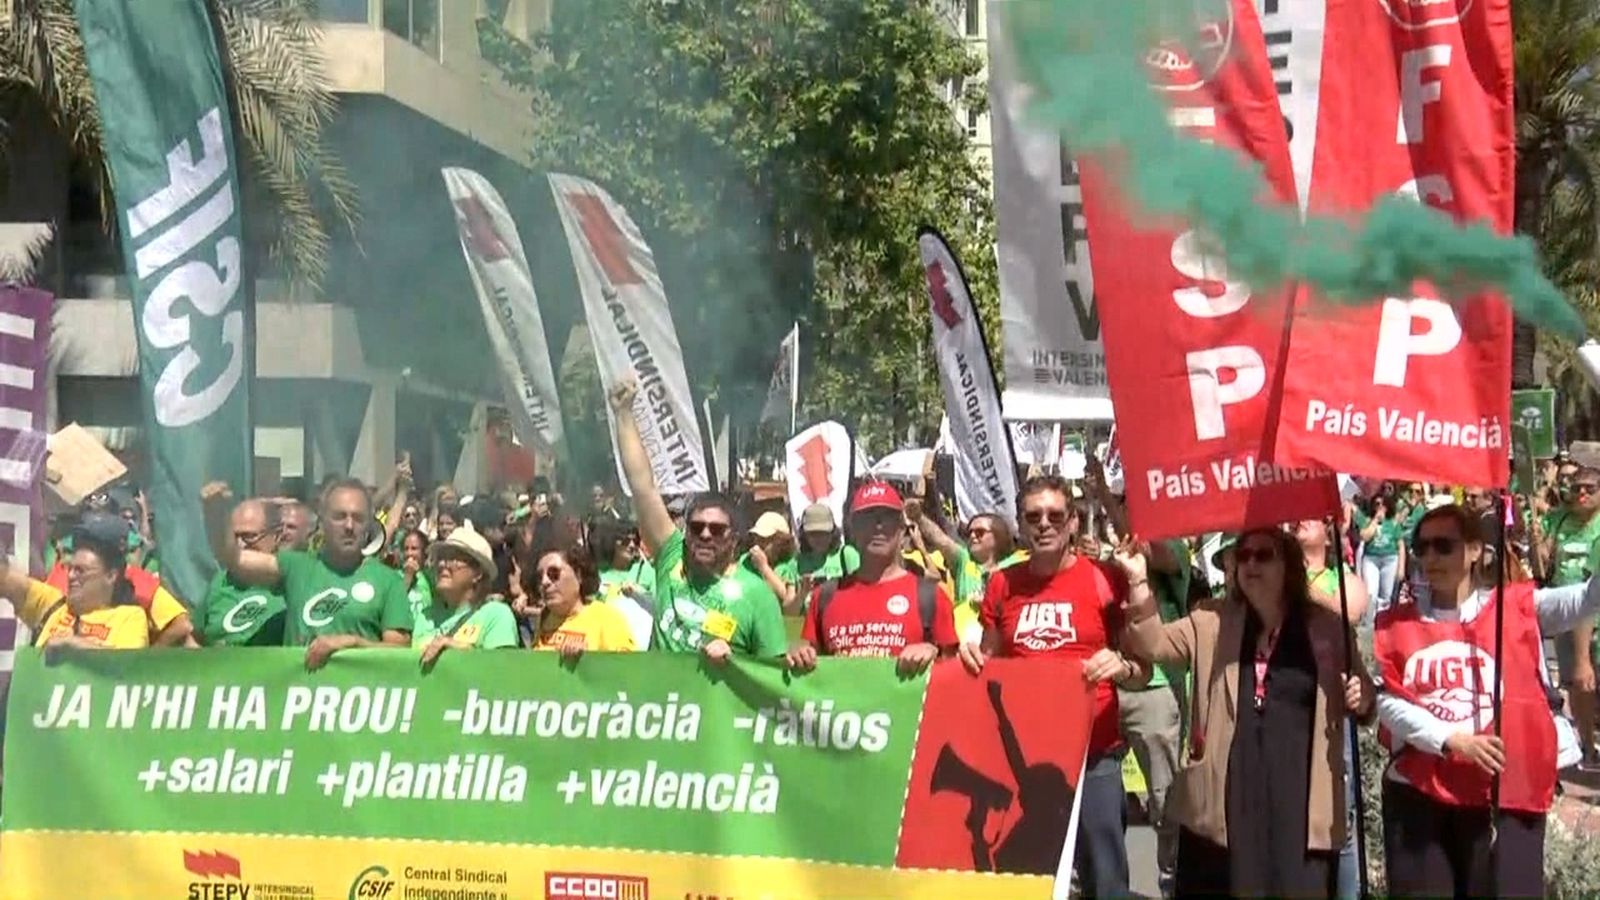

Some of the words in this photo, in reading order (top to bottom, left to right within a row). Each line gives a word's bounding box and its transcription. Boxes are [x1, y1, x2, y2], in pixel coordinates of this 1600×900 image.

[1305, 399, 1367, 437] País
[1378, 406, 1502, 449] Valencià
[1147, 464, 1206, 501] País
[849, 624, 863, 634] un
[1017, 602, 1073, 632] UGT
[1413, 656, 1486, 694] UGT
[33, 685, 92, 729] JA
[208, 685, 266, 730] HA
[280, 685, 417, 735] PROU!
[443, 688, 701, 742] -burocràcia
[733, 697, 893, 753] -ràtios
[138, 747, 293, 796] +salari
[316, 751, 528, 808] +plantilla
[556, 760, 780, 816] +valencià
[357, 879, 395, 898] CSIF
[404, 867, 450, 881] Central
[455, 868, 507, 884] Sindical
[549, 877, 617, 896] CCOO
[188, 883, 250, 900] STEPV
